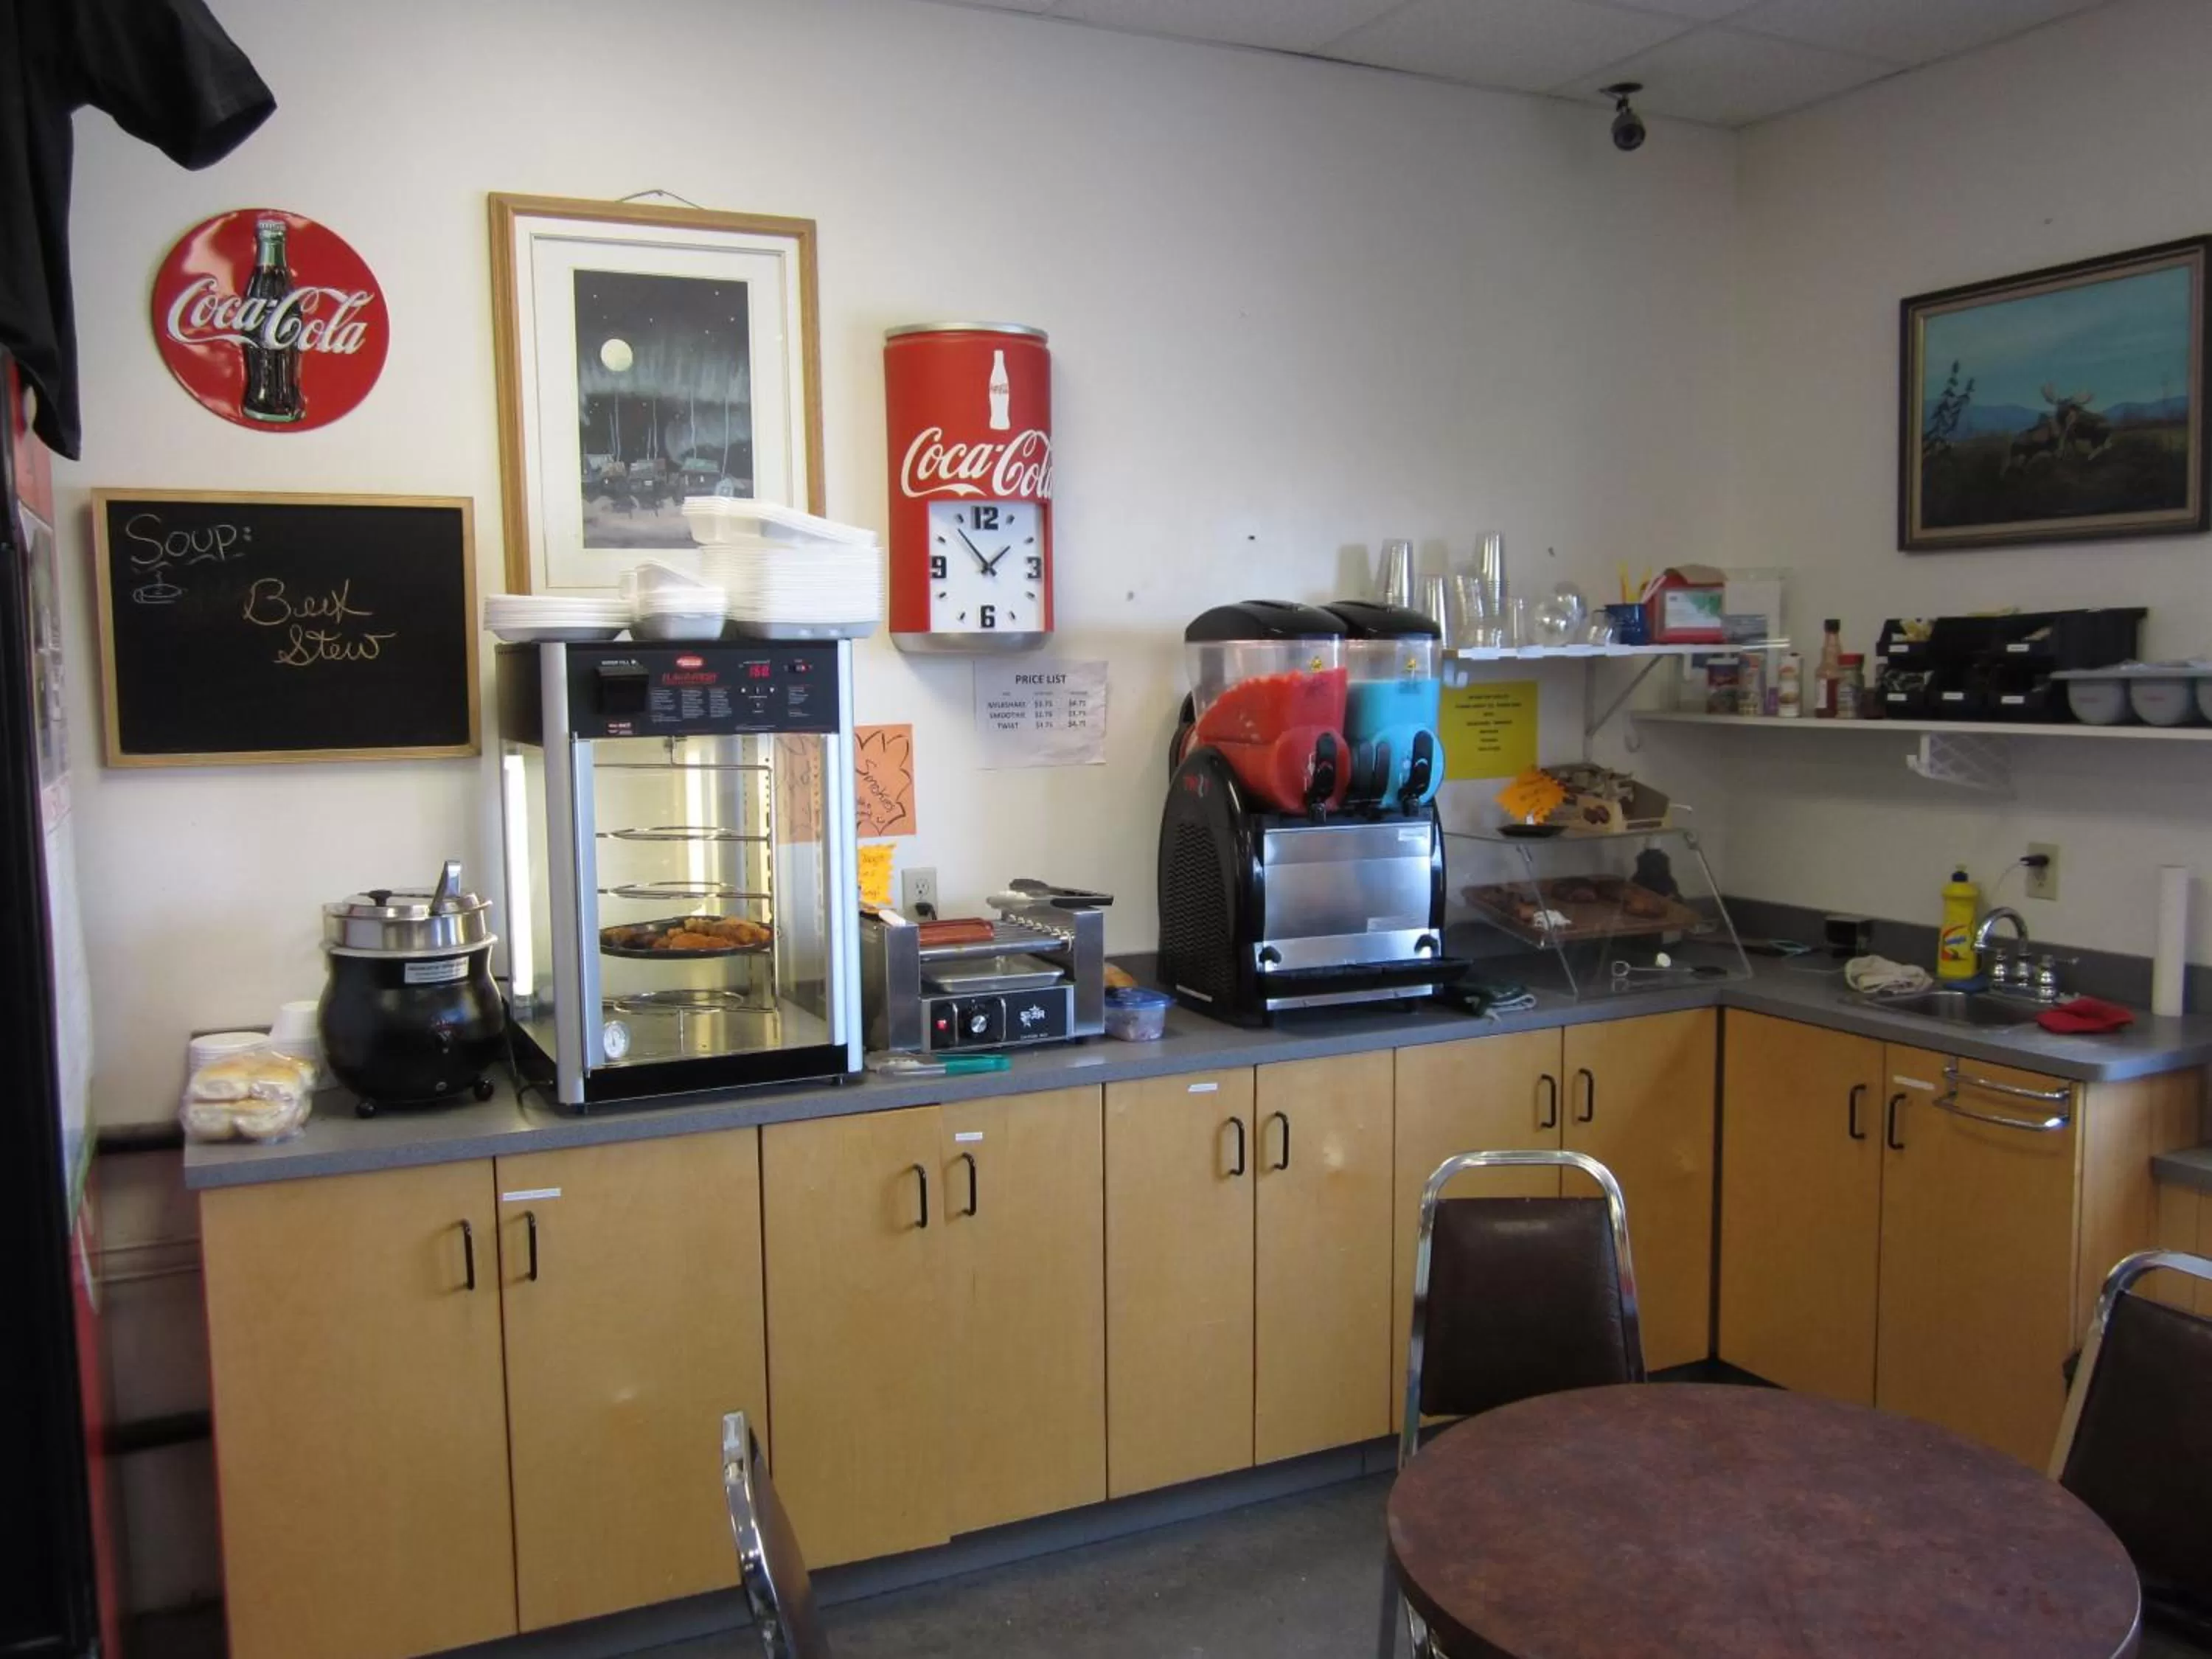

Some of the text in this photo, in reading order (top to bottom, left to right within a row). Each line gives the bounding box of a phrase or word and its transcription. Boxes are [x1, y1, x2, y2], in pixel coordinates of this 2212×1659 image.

[167, 277, 375, 354] Coca-Cola
[971, 505, 999, 530] 12
[930, 556, 947, 578] 9
[1027, 556, 1042, 579] 3
[981, 605, 995, 628] 6
[273, 625, 396, 665] Stew
[1015, 674, 1067, 684] PRICE LIST
